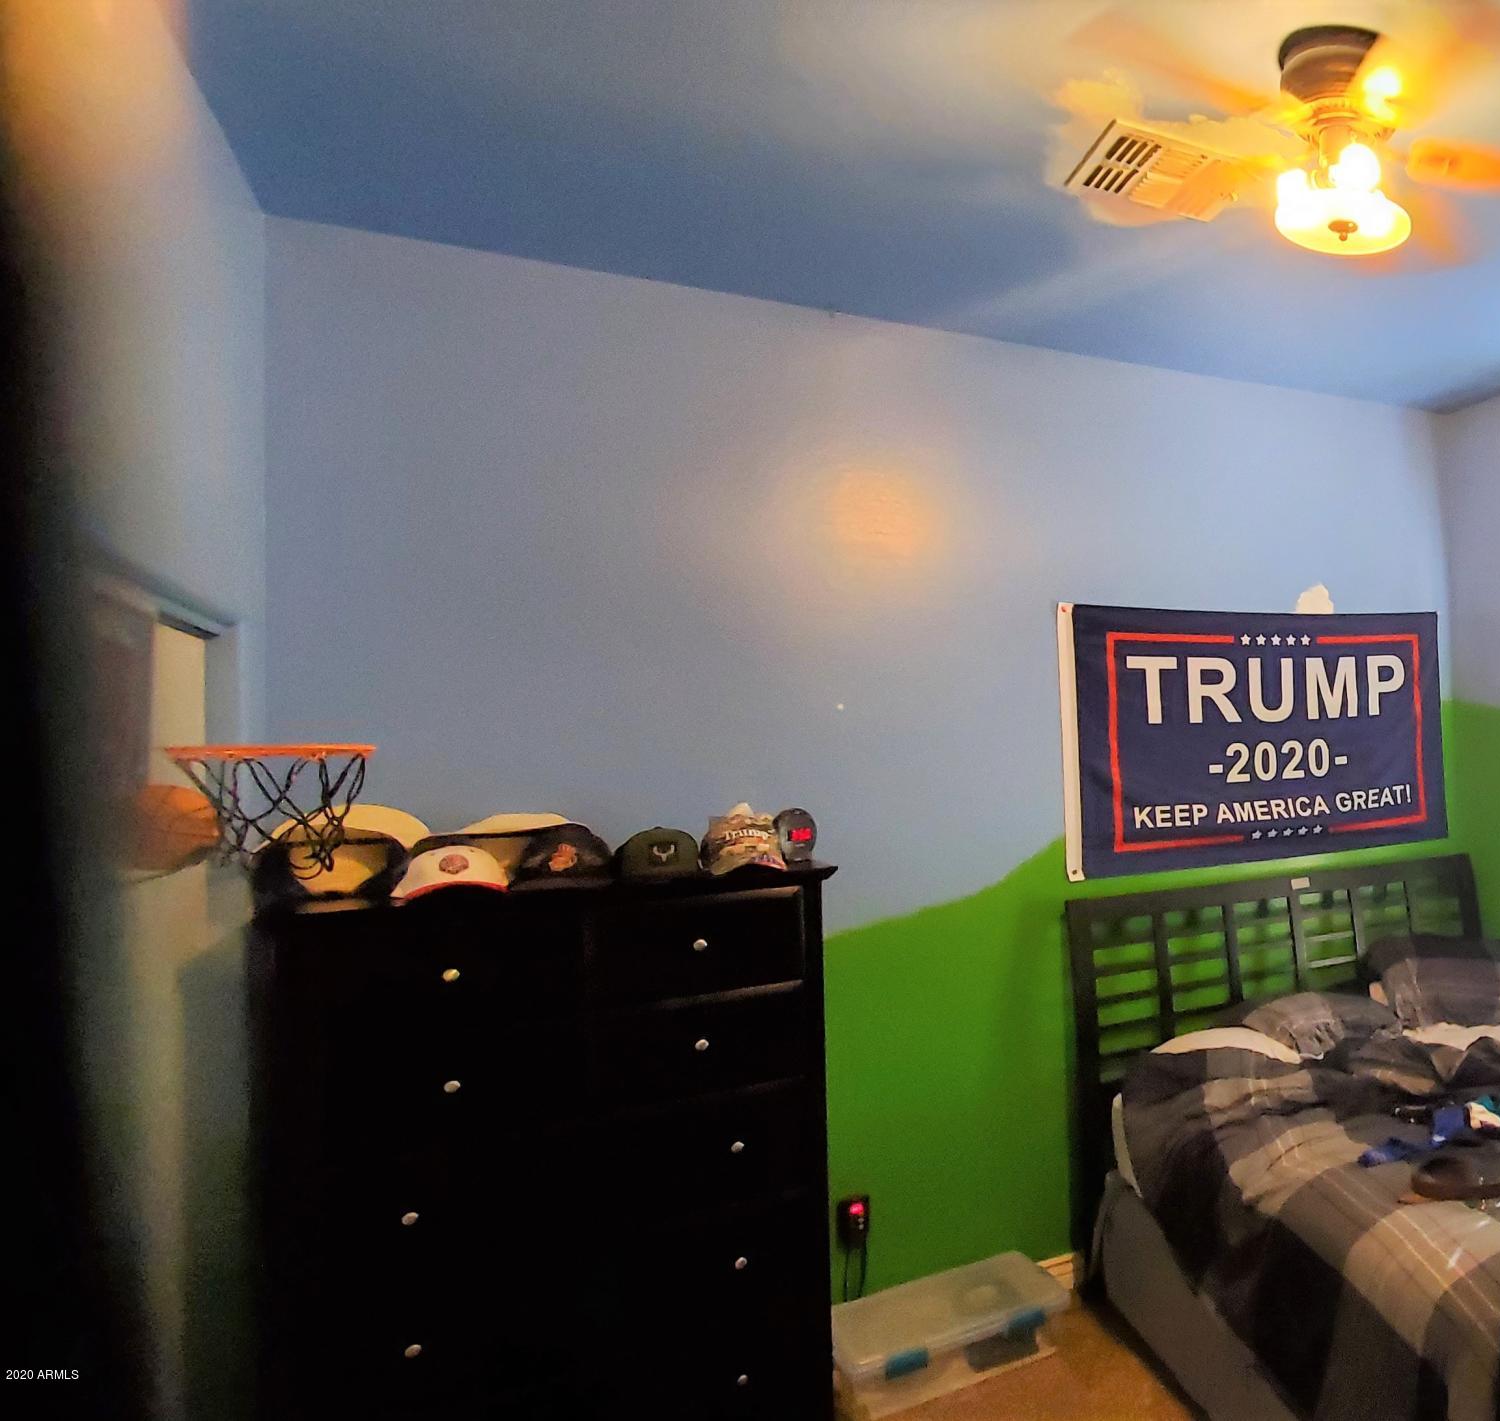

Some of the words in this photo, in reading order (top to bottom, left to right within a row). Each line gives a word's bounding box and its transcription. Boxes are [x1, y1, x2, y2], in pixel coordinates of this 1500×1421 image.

[1126, 654, 1405, 724] TRUMP
[1207, 738, 1349, 783] -2020-
[1132, 803, 1209, 830] KEEP
[1215, 794, 1331, 825] AMERICA
[1334, 783, 1413, 813] GREAT!
